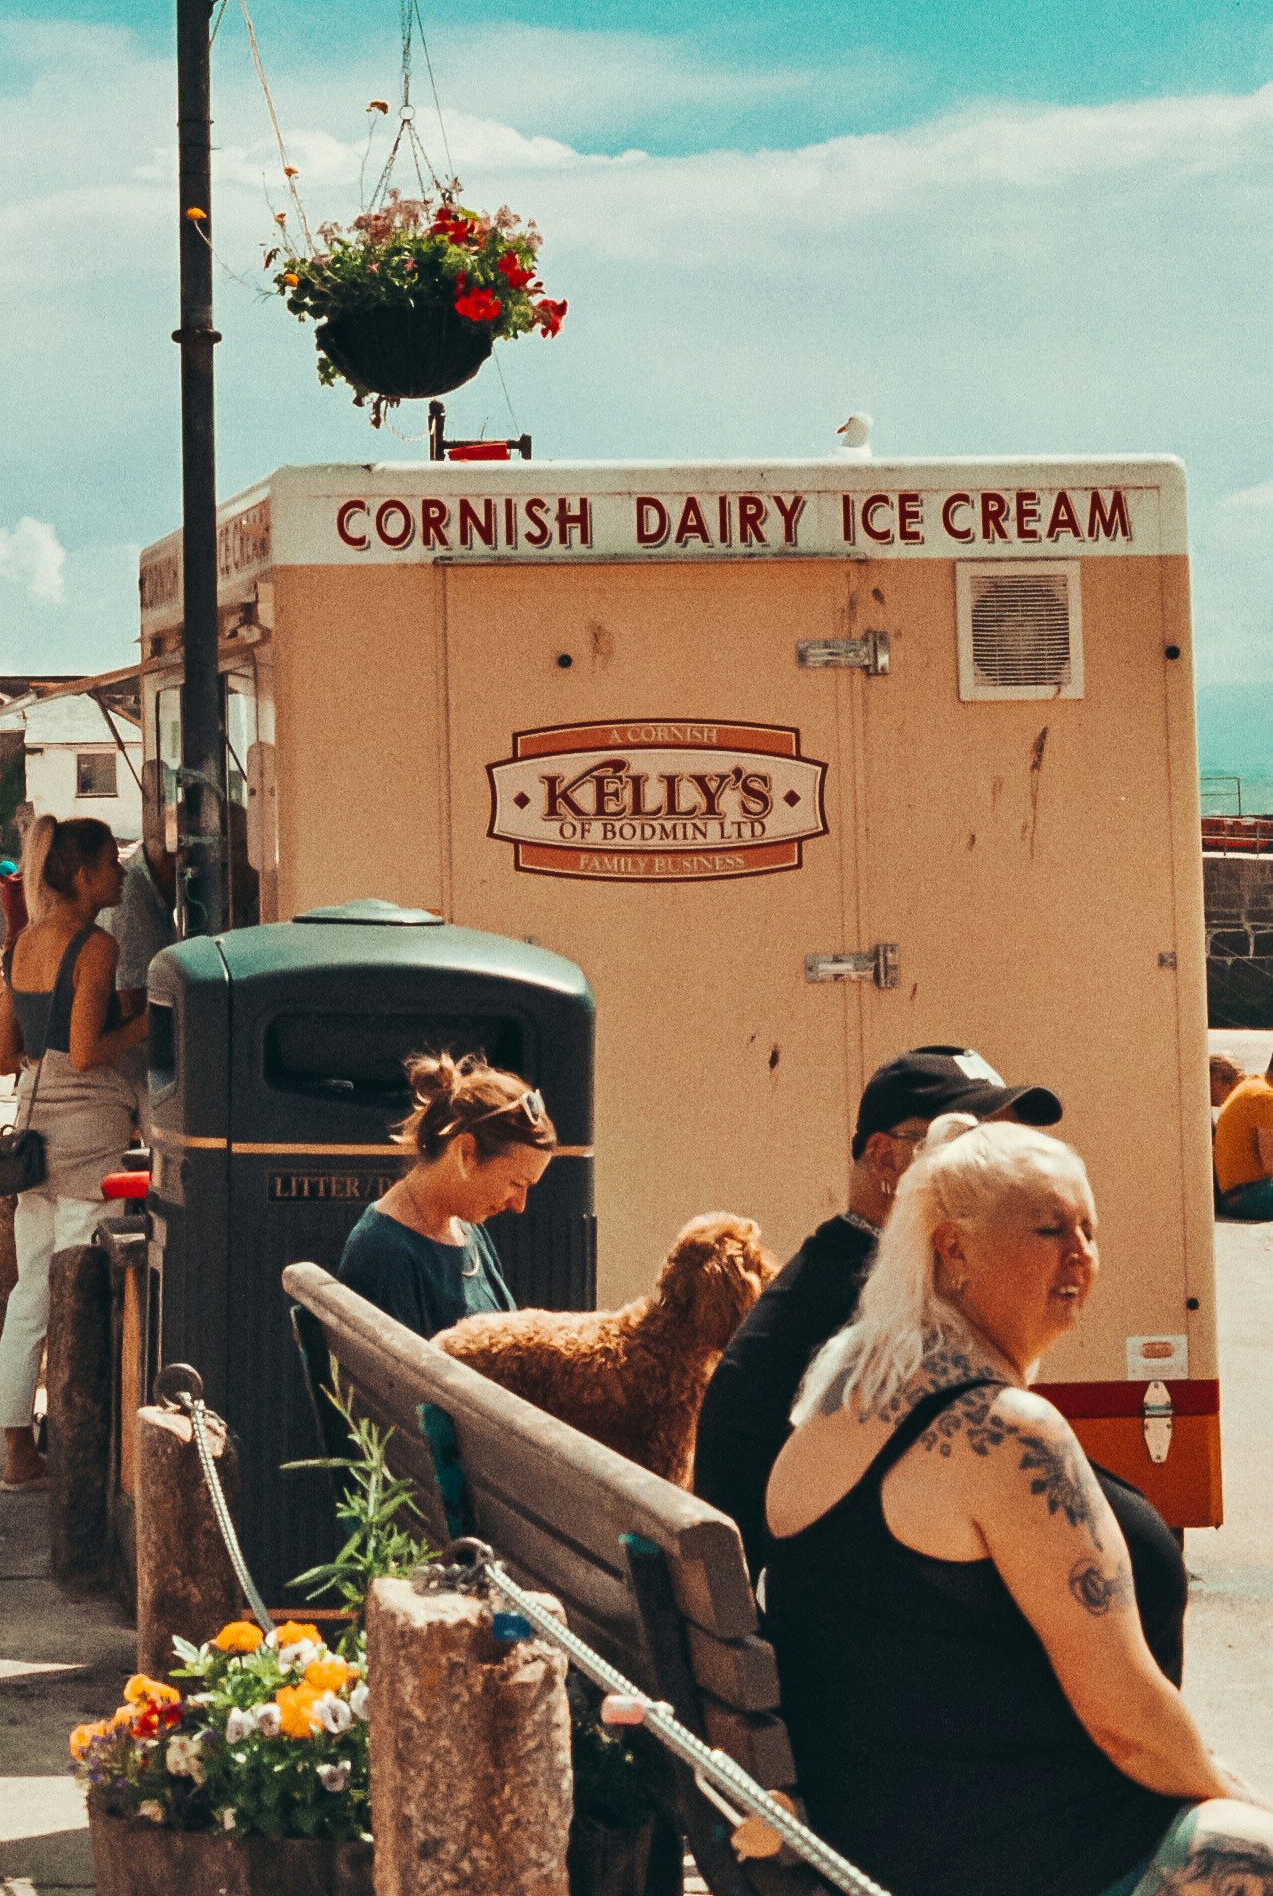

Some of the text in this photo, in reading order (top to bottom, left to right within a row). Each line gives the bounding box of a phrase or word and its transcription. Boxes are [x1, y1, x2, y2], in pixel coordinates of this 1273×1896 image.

[336, 490, 1132, 550] CORNISH DAIRY ICE CREAM
[609, 726, 719, 744] A CORNISH
[540, 759, 772, 820] KELLY'S
[559, 821, 766, 841] OF BODMIN LTD
[578, 855, 745, 873] FAMILY BUSINESS
